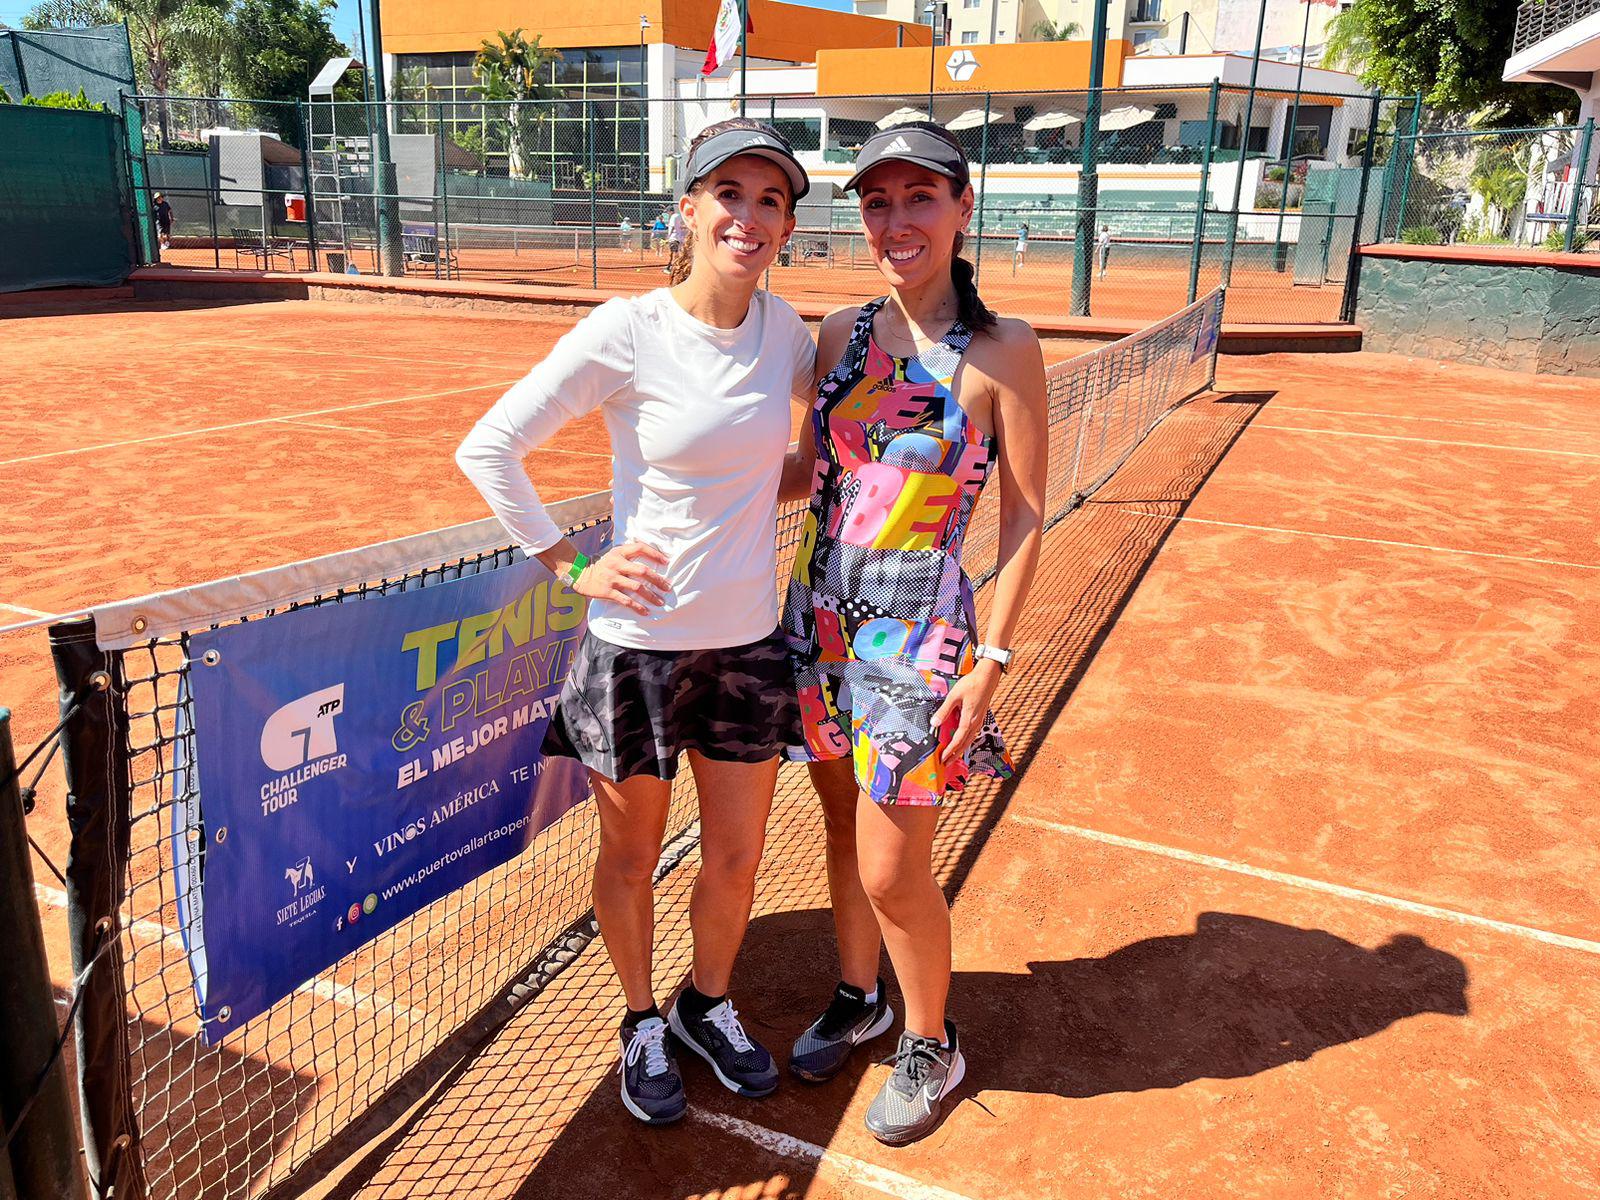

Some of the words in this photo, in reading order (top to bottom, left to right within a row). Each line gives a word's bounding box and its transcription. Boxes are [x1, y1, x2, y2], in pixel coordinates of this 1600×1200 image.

[873, 383, 897, 393] adidas
[401, 579, 587, 691] TENIS
[317, 699, 340, 718] ATP
[391, 700, 430, 752] &
[442, 637, 581, 732] PLAYA
[397, 758, 429, 790] EL
[432, 716, 508, 771] MEJOR
[512, 694, 561, 730] MAT
[260, 753, 347, 801] CHALLENGER
[261, 788, 298, 816] TOUR
[373, 817, 426, 857] VINOS
[429, 779, 501, 829] AMÉRICA
[510, 766, 529, 784] TE
[345, 856, 358, 874] Y
[382, 807, 537, 900] www.puertovallartaopen.
[276, 901, 298, 925] SIETE
[300, 885, 326, 912] LEGUAS
